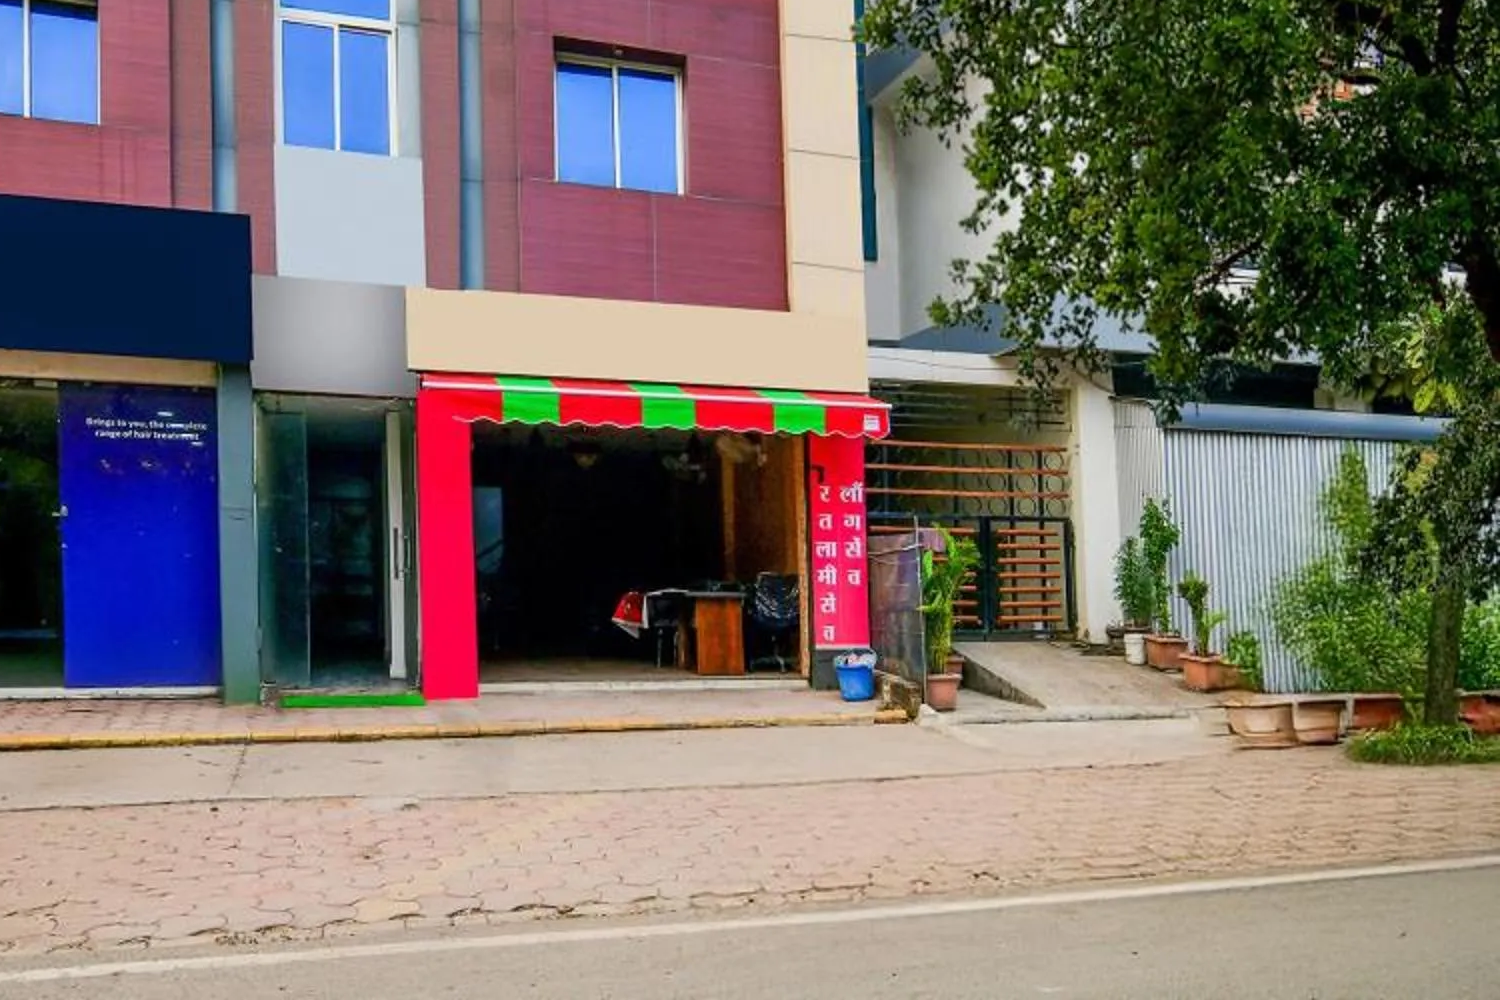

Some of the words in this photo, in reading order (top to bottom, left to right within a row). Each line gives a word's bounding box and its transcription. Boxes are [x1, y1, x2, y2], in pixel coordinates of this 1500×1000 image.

[85, 417, 116, 428] Brings
[117, 418, 127, 428] to
[149, 420, 165, 429] the
[95, 430, 121, 439] range
[122, 430, 133, 439] of
[133, 430, 151, 439] hair
